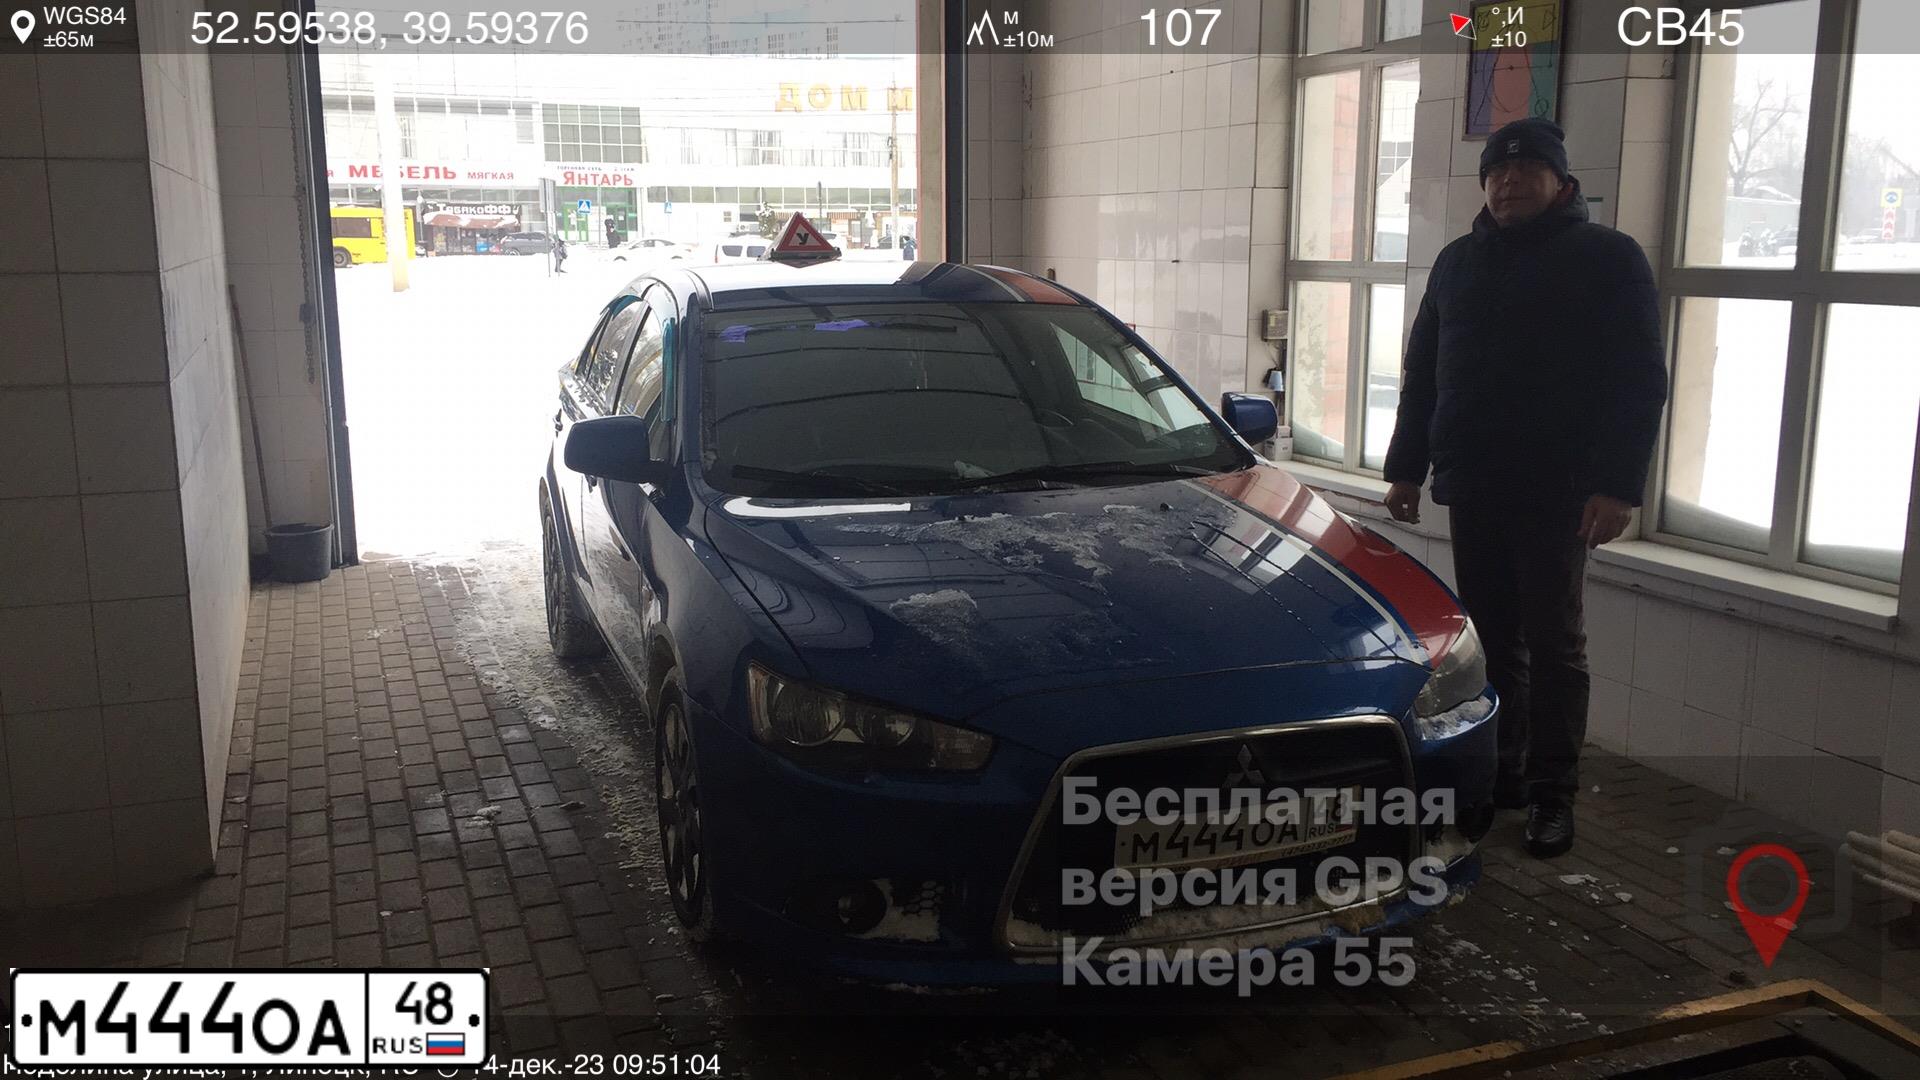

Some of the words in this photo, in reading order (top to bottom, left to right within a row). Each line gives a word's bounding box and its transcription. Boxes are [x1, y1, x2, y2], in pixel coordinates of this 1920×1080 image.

[775, 82, 868, 112] ДОМ
[350, 164, 457, 180] МЕЕЛЬ
[563, 171, 633, 187] ЯНТАРЬ
[1308, 822, 1335, 839] RUS
